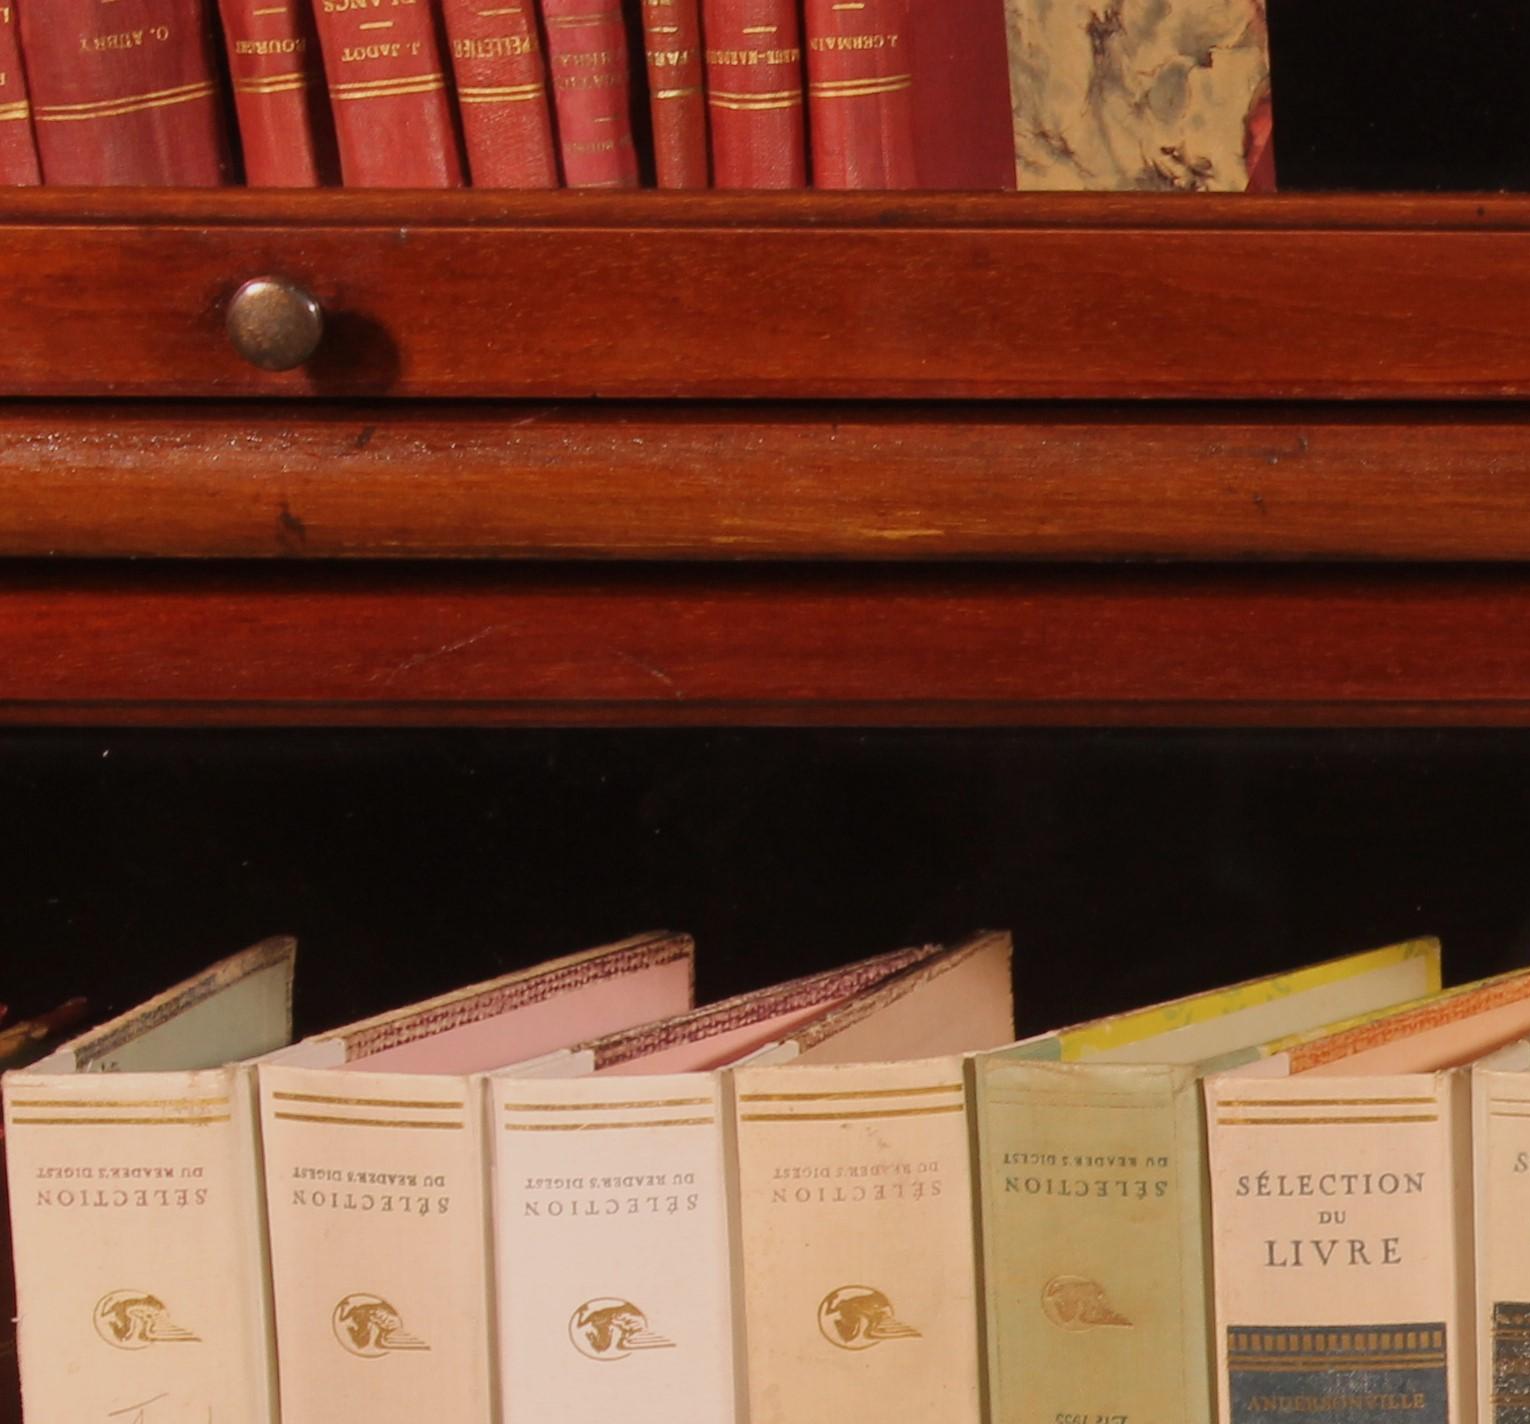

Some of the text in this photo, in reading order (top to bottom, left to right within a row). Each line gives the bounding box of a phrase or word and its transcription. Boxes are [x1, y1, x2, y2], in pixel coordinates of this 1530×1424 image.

[341, 42, 400, 61] JADOT
[1003, 1153, 1169, 1168] DU READER'S DIGEST
[36, 1167, 204, 1179] DU READER'S DIGEST
[292, 1167, 446, 1188] DU READER'S DIGEST
[524, 1173, 696, 1190] DU READER'S DIGEST
[772, 1166, 831, 1180] DIGEST
[1236, 1170, 1425, 1196] SÉLECTION
[36, 1188, 209, 1208] SÉLECTION
[770, 1180, 942, 1203] SÉLECTION
[1003, 1177, 1169, 1201] SÉLECTION
[291, 1190, 450, 1217] SÉLECTION
[523, 1194, 699, 1217] SÉLECTION
[1317, 1210, 1347, 1225] DU
[1264, 1237, 1402, 1267] LIVRE
